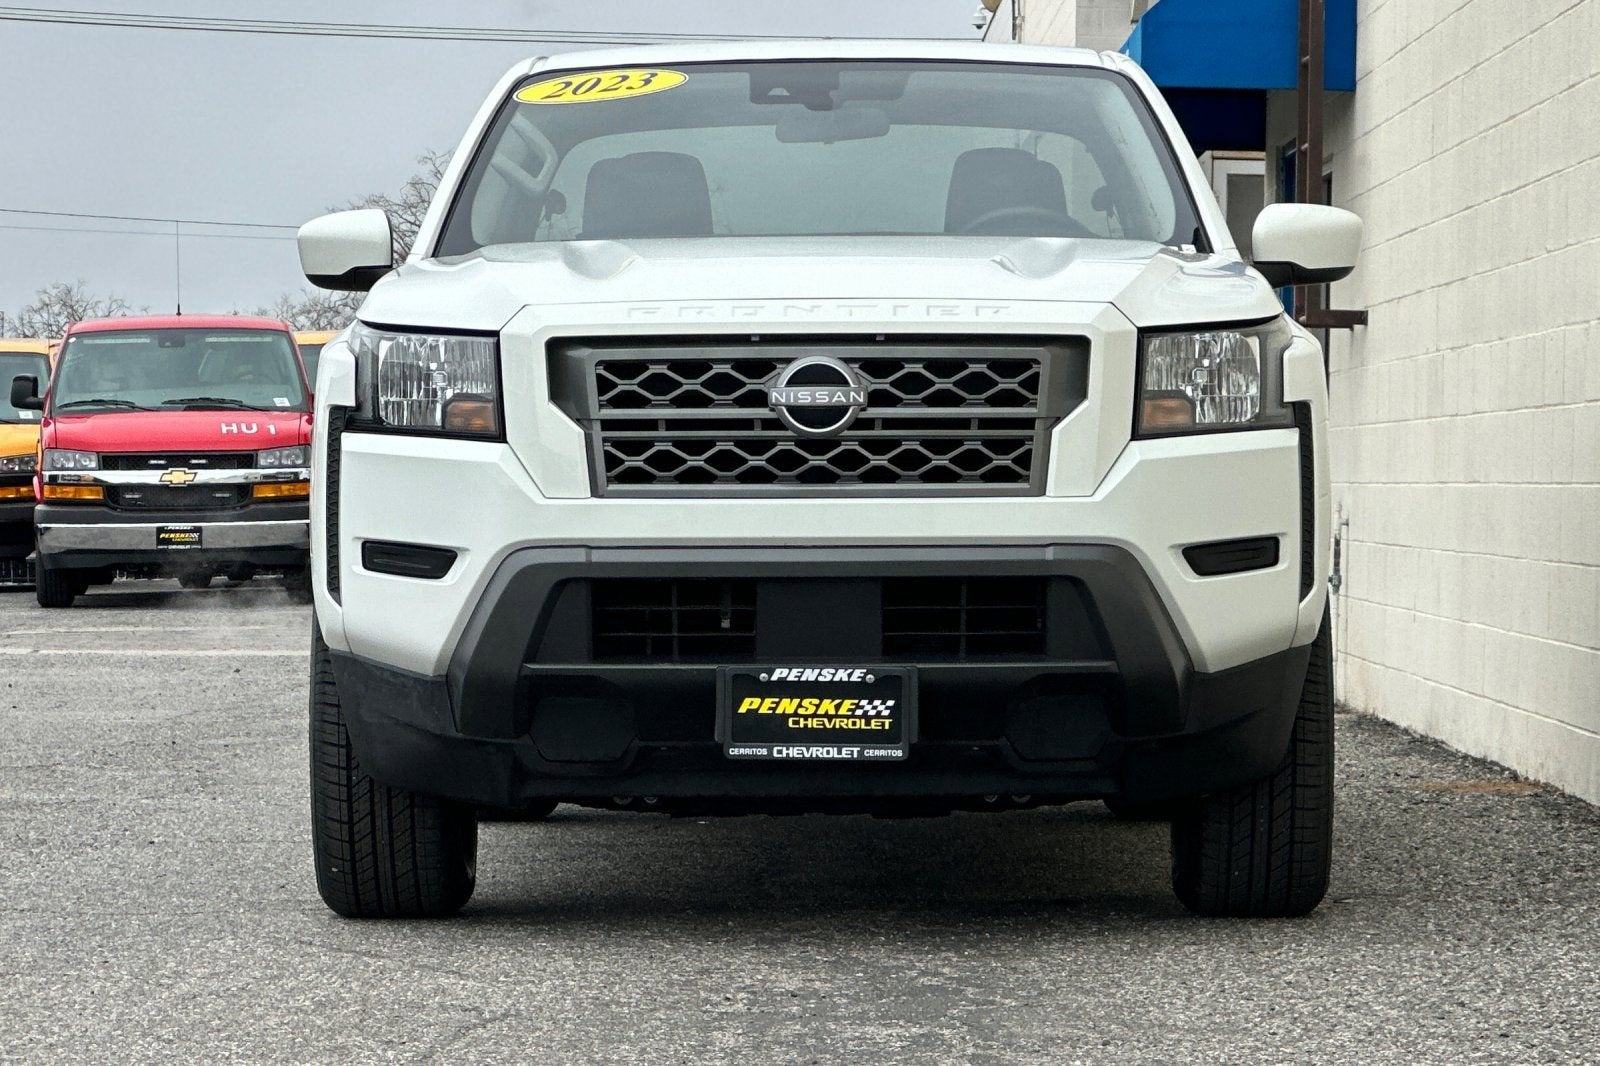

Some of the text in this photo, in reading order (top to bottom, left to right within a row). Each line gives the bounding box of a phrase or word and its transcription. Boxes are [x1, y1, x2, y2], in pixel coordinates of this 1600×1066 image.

[540, 72, 658, 100] 2023
[628, 304, 1011, 319] FRONTIER
[772, 391, 864, 403] NISSAN
[221, 422, 276, 435] HU 1
[770, 668, 867, 682] PENSKE
[738, 697, 858, 715] PENSKE
[788, 717, 893, 730] CHEVROLET
[772, 746, 860, 758] CHEVROLET
[864, 749, 903, 757] CERRITOS
